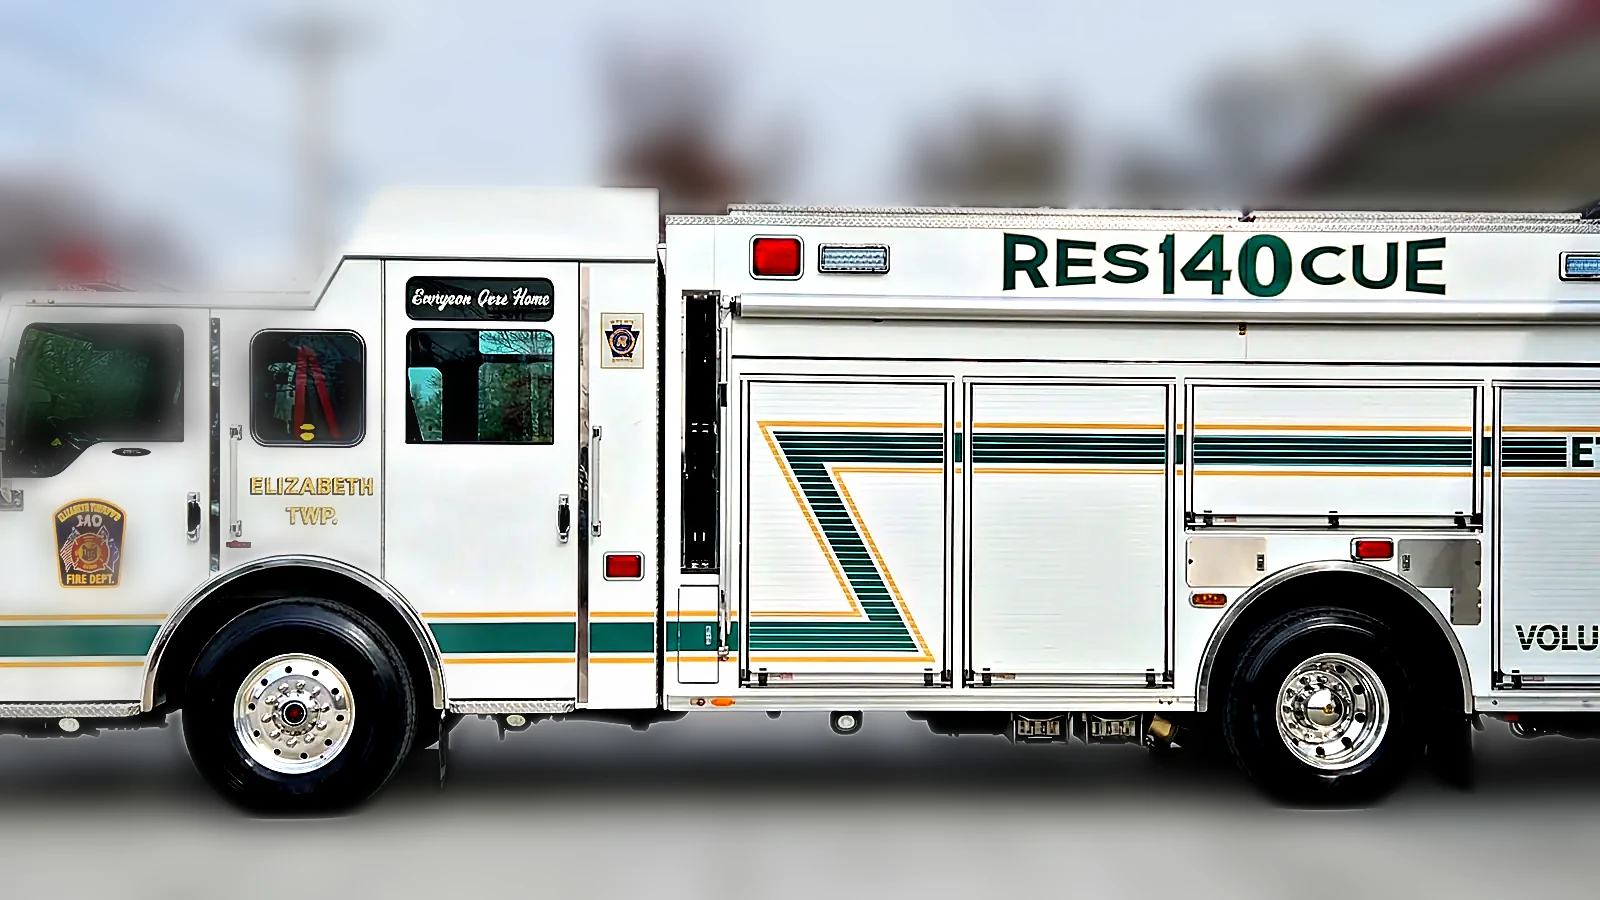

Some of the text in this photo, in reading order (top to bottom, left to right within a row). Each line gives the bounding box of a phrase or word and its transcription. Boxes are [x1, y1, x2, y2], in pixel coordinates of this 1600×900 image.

[1572, 436, 1600, 467] E
[249, 477, 374, 496] ELIZABETH
[285, 506, 338, 525] TWP.
[66, 573, 115, 585] FIRE DEPT.
[1514, 624, 1599, 651] VOLU
